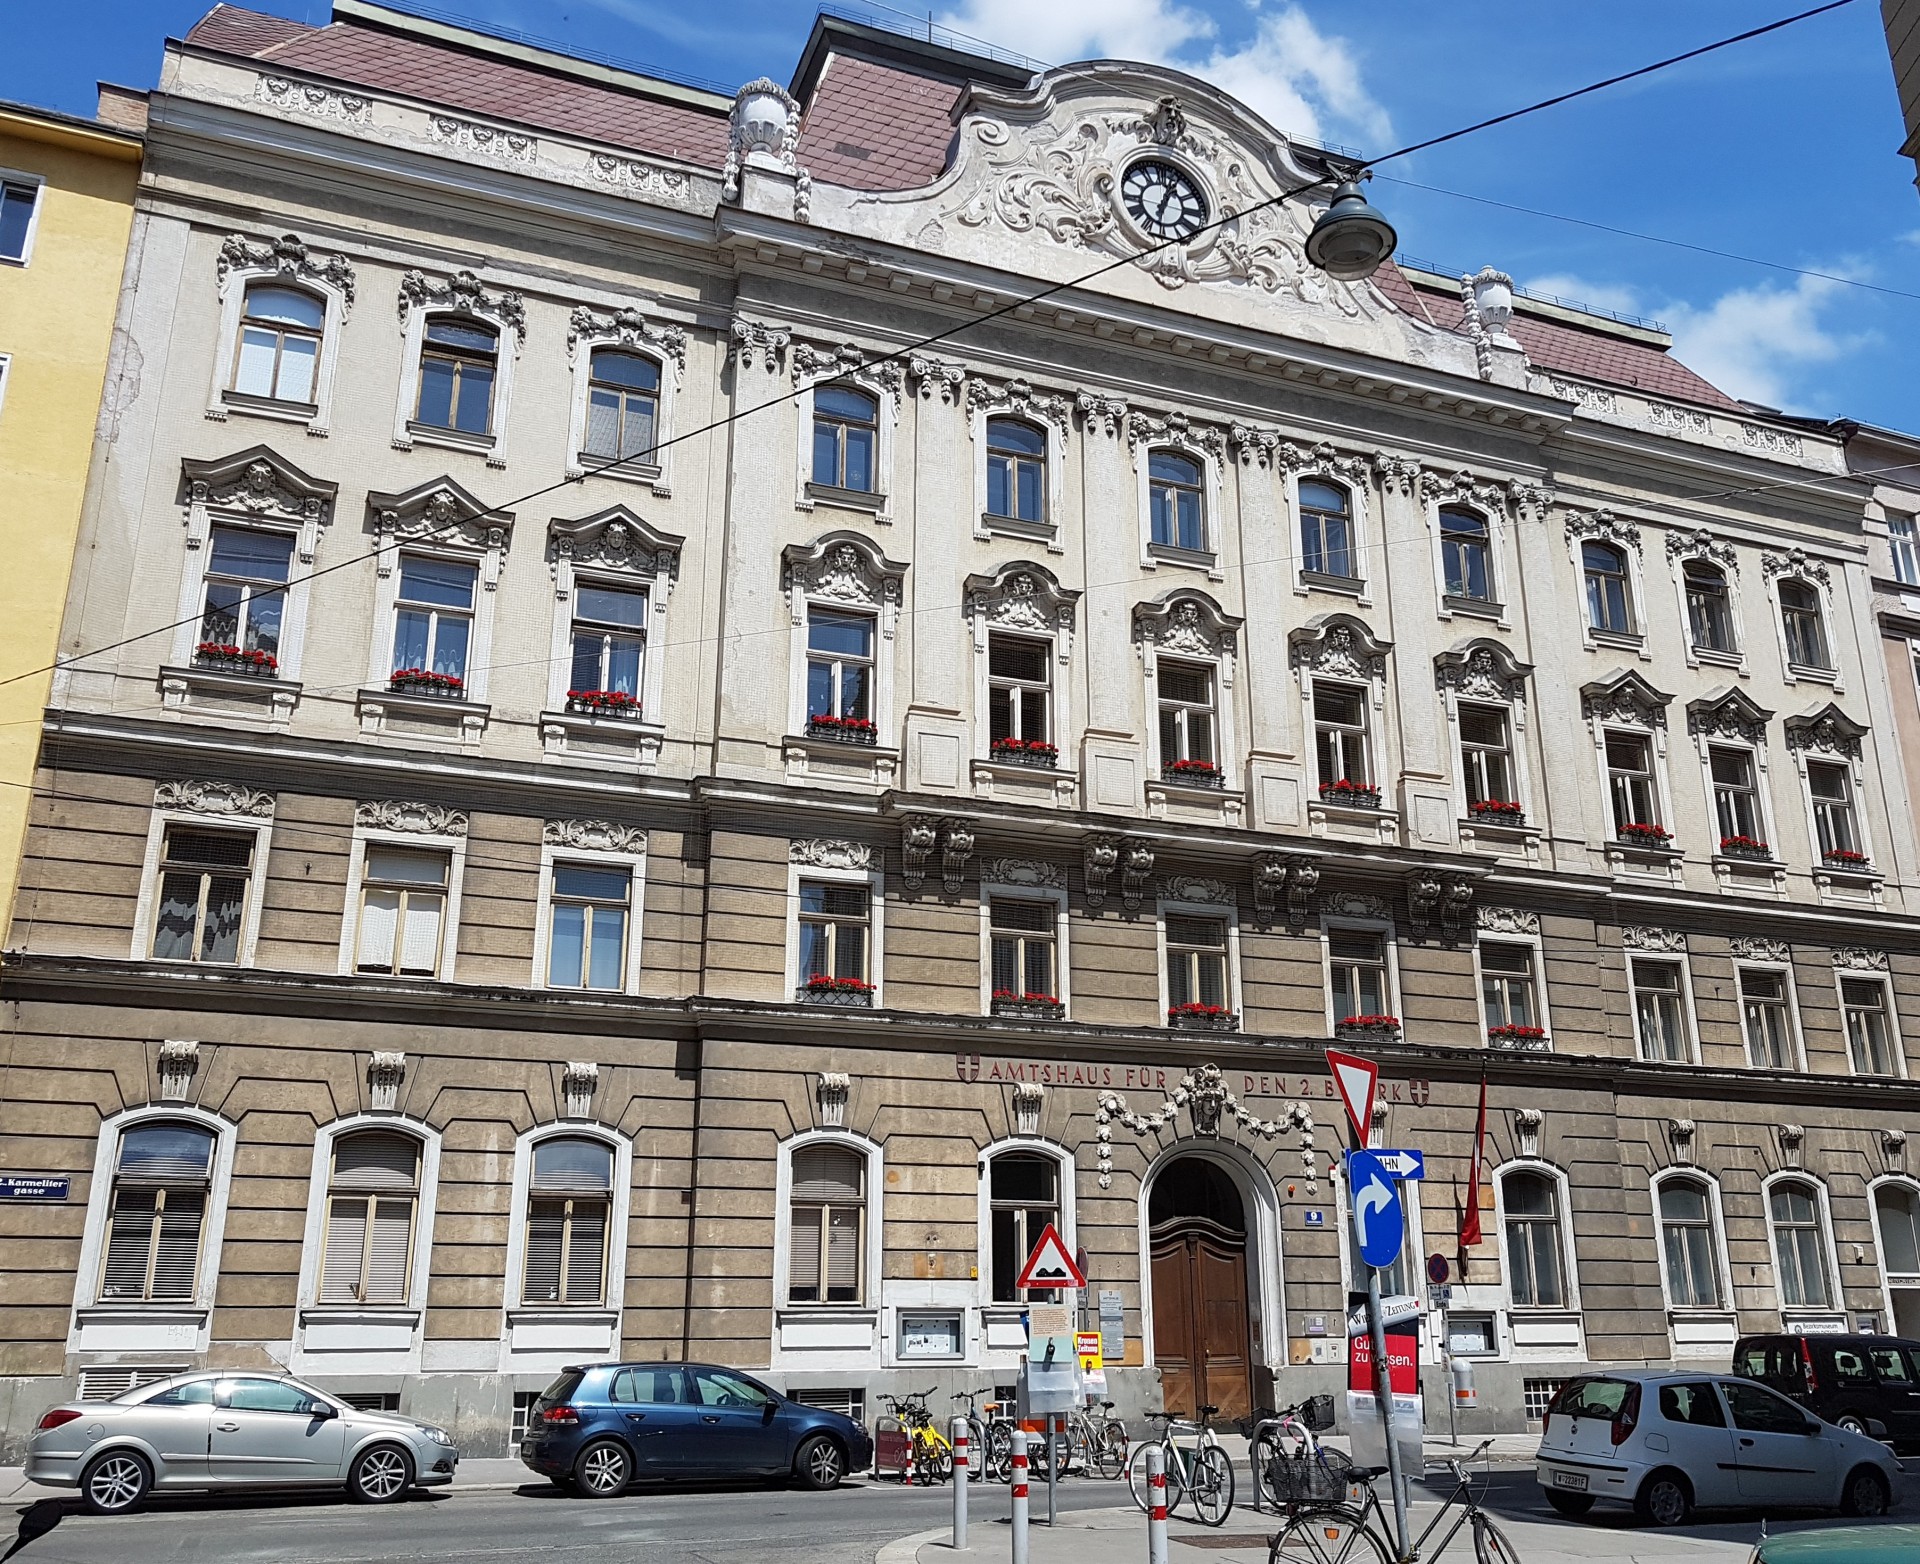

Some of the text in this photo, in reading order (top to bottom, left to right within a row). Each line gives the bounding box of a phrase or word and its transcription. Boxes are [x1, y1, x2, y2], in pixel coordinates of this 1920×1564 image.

[989, 1061, 1402, 1101] AMTSHAUS FÜR DEN 2. BRK
[8, 1178, 68, 1188] Karmeliter-
[14, 1188, 45, 1196] gasse
[1310, 1211, 1318, 1221] 9
[1385, 1302, 1416, 1317] ZEITUNG
[1355, 1352, 1368, 1363] zu
